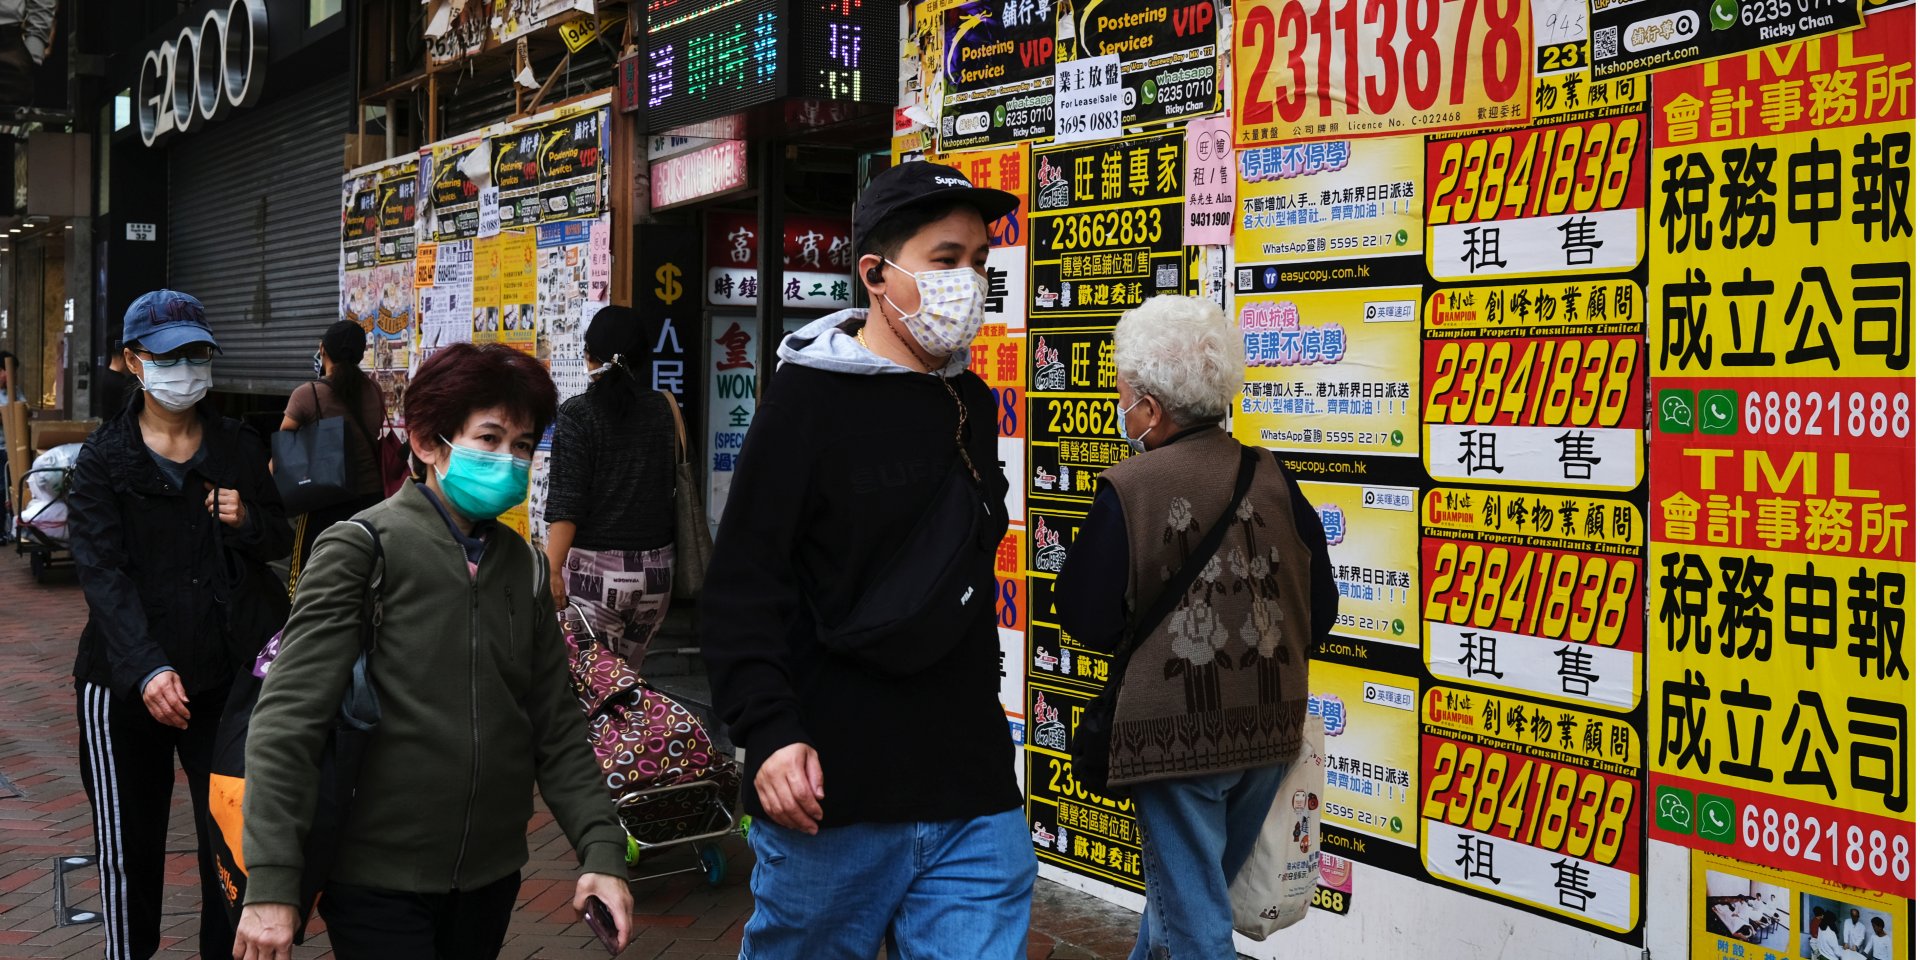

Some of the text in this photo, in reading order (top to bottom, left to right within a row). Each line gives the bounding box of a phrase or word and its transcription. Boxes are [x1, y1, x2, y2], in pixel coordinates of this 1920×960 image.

[1097, 2, 1213, 38] Postering VIP
[1760, 13, 1834, 41] Ricky Chan
[962, 36, 1053, 68] Postering VIP
[1099, 33, 1153, 56] Services
[139, 0, 258, 147] G2000
[961, 64, 1005, 84] Services
[1242, 0, 1522, 125] 23113878
[1594, 45, 1700, 77] hkshopexpert.com
[1059, 63, 1119, 93] 業主放盤
[1156, 65, 1214, 86] whatsapp
[1006, 94, 1053, 109] whatsapp
[1061, 100, 1072, 109] For
[1158, 79, 1213, 103] 6235 0710
[1662, 62, 1914, 143] 會計事務所
[1005, 106, 1053, 127] 6235 0710
[1166, 100, 1204, 115] Ricky Chan
[1597, 102, 1644, 118] Limited
[1013, 125, 1045, 138] Ricky Chan
[1058, 110, 1119, 135] 3695 0883
[1293, 122, 1340, 135] 公司牌照
[1348, 119, 1382, 131] Licence
[1388, 117, 1405, 127] No.
[1412, 112, 1461, 126] C-022468
[943, 134, 990, 148] hkshopexpert.com
[580, 147, 597, 167] VIP
[1074, 144, 1178, 201] 旺舖專家
[1428, 118, 1639, 225] 23841838
[1216, 193, 1232, 204] Alan
[1320, 181, 1414, 206] 港九新界日日派送
[1659, 131, 1914, 254] 稅務申報
[1051, 207, 1162, 250] 23662833
[1330, 237, 1358, 249] 5595
[1362, 234, 1393, 247] 2217
[1280, 264, 1370, 284] easycopy.com.hk
[1078, 282, 1142, 306] 歡迎委託
[1243, 308, 1296, 329] 同心抗疫
[1659, 261, 1911, 371] 成立公司
[1243, 329, 1344, 361] 停課不停學
[1426, 323, 1640, 339] Champion Property Consultants Limited
[1316, 382, 1410, 399] 港九新界日日派送
[1424, 338, 1637, 427] 23841838
[1048, 400, 1120, 434] 23662
[1744, 391, 1910, 438] 68821888
[1326, 431, 1354, 443] 5595
[1358, 432, 1388, 445] 2217
[1283, 458, 1367, 475] asycopy.com.hk
[1683, 448, 1880, 498] TML
[1660, 490, 1908, 557] 會計事務所
[1424, 527, 1639, 556] Champion Property Consultants Limited
[1424, 542, 1635, 647] 23841838
[1359, 618, 1389, 632] 2217
[1659, 552, 1909, 680] 稅務申報
[1424, 723, 1637, 777] Champion Property Consultants Limited
[1658, 668, 1908, 813] 成立公司
[1325, 802, 1387, 828] 5595 2217
[1422, 742, 1633, 865] 23841838
[1074, 835, 1140, 875] 歡迎委託
[1742, 804, 1910, 882] 68821888
